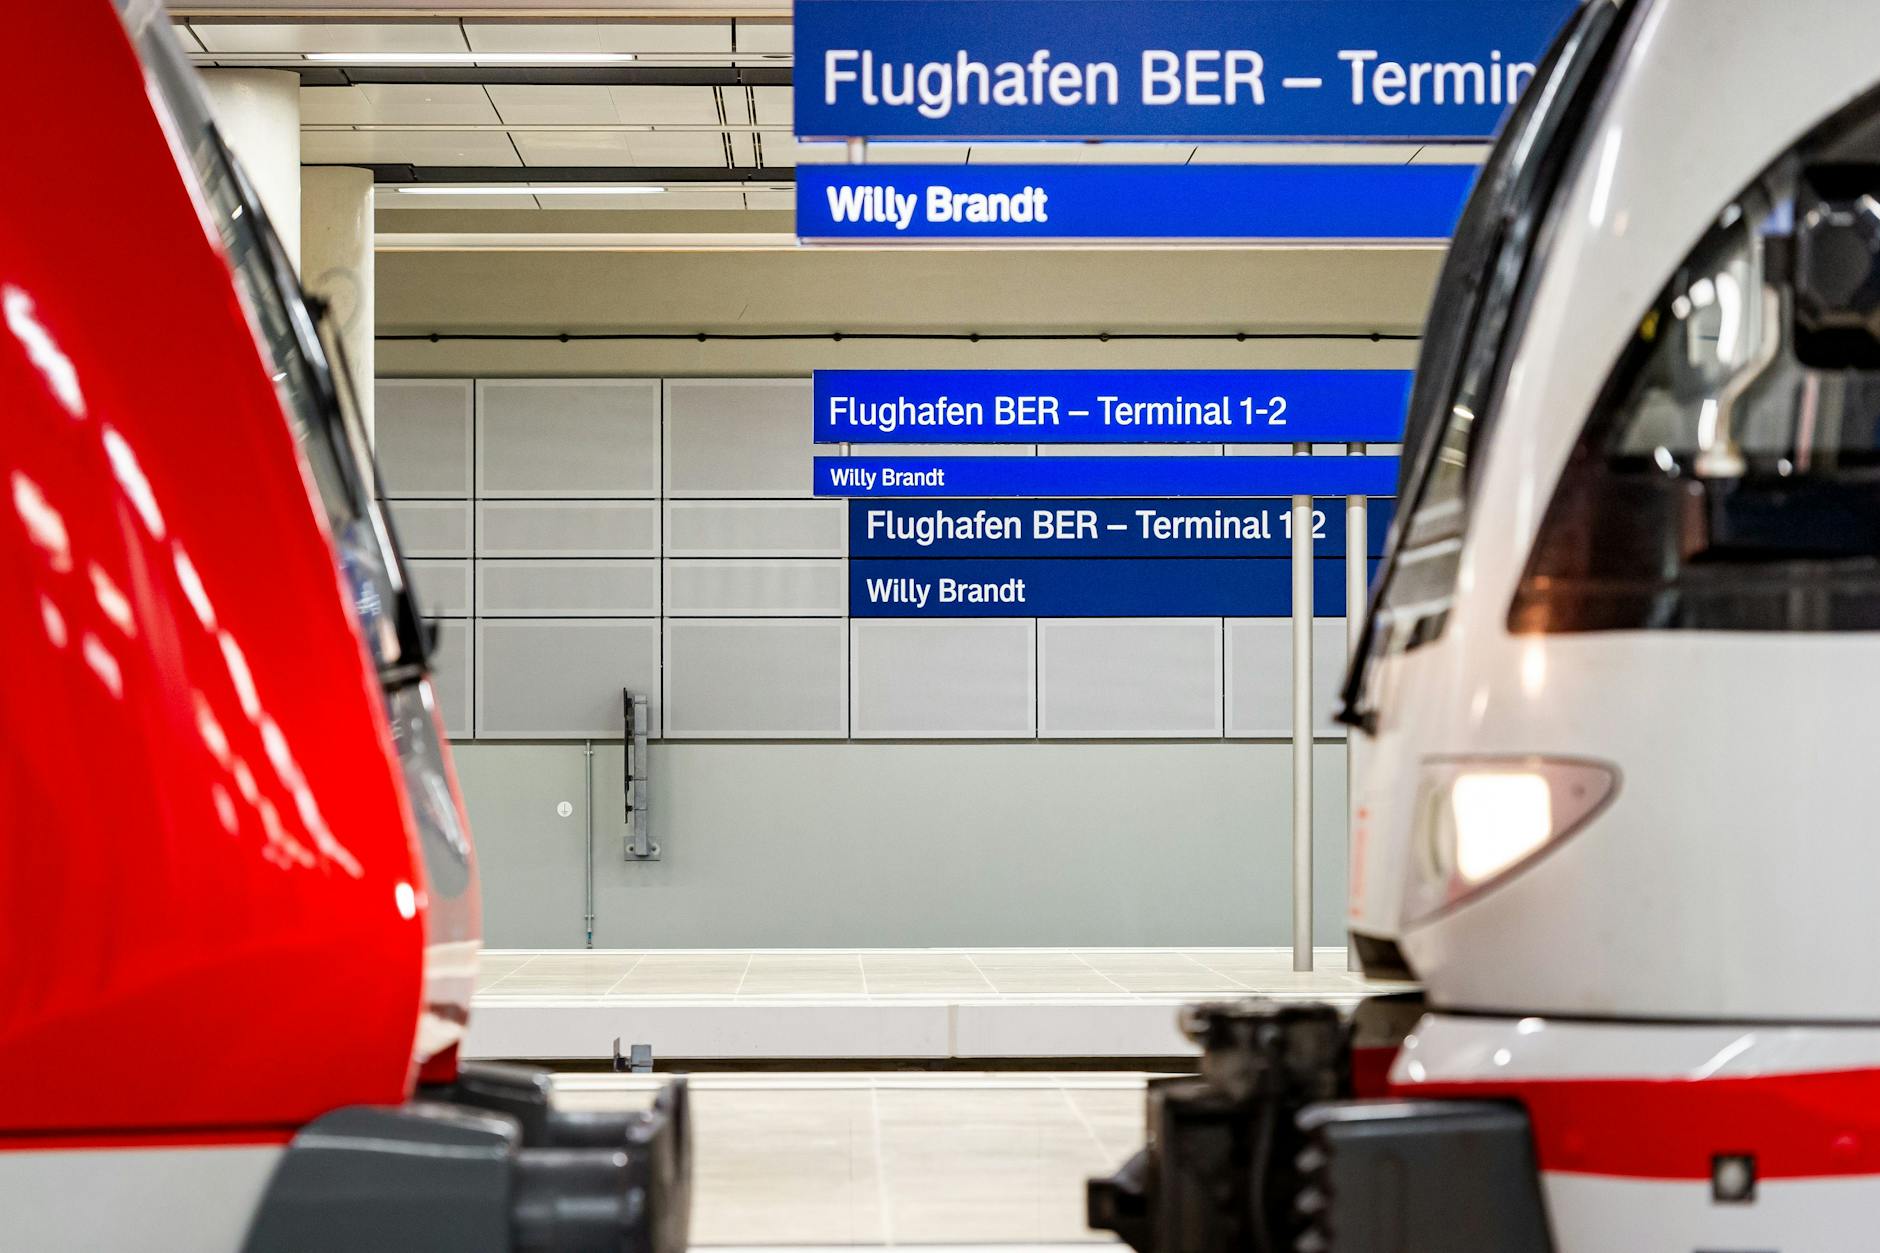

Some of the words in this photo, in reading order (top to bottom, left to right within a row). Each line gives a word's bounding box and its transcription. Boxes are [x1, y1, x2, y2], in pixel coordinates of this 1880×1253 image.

[825, 49, 1119, 119] Flughafen
[1141, 49, 1265, 106] BER
[826, 185, 918, 230] Willy
[926, 185, 1048, 223] Brandt
[830, 396, 983, 433] Flughafen
[995, 396, 1060, 425] BER
[1096, 396, 1232, 426] Terminal
[1240, 396, 1287, 425] 1-2
[830, 467, 877, 491] Willy
[882, 467, 945, 487] Brandt
[867, 509, 1022, 546] Flughafen
[1033, 510, 1099, 539] BER
[1135, 509, 1271, 540] Terminal
[1279, 510, 1326, 539] 12
[866, 578, 931, 609] Willy
[939, 578, 1026, 603] Brandt
